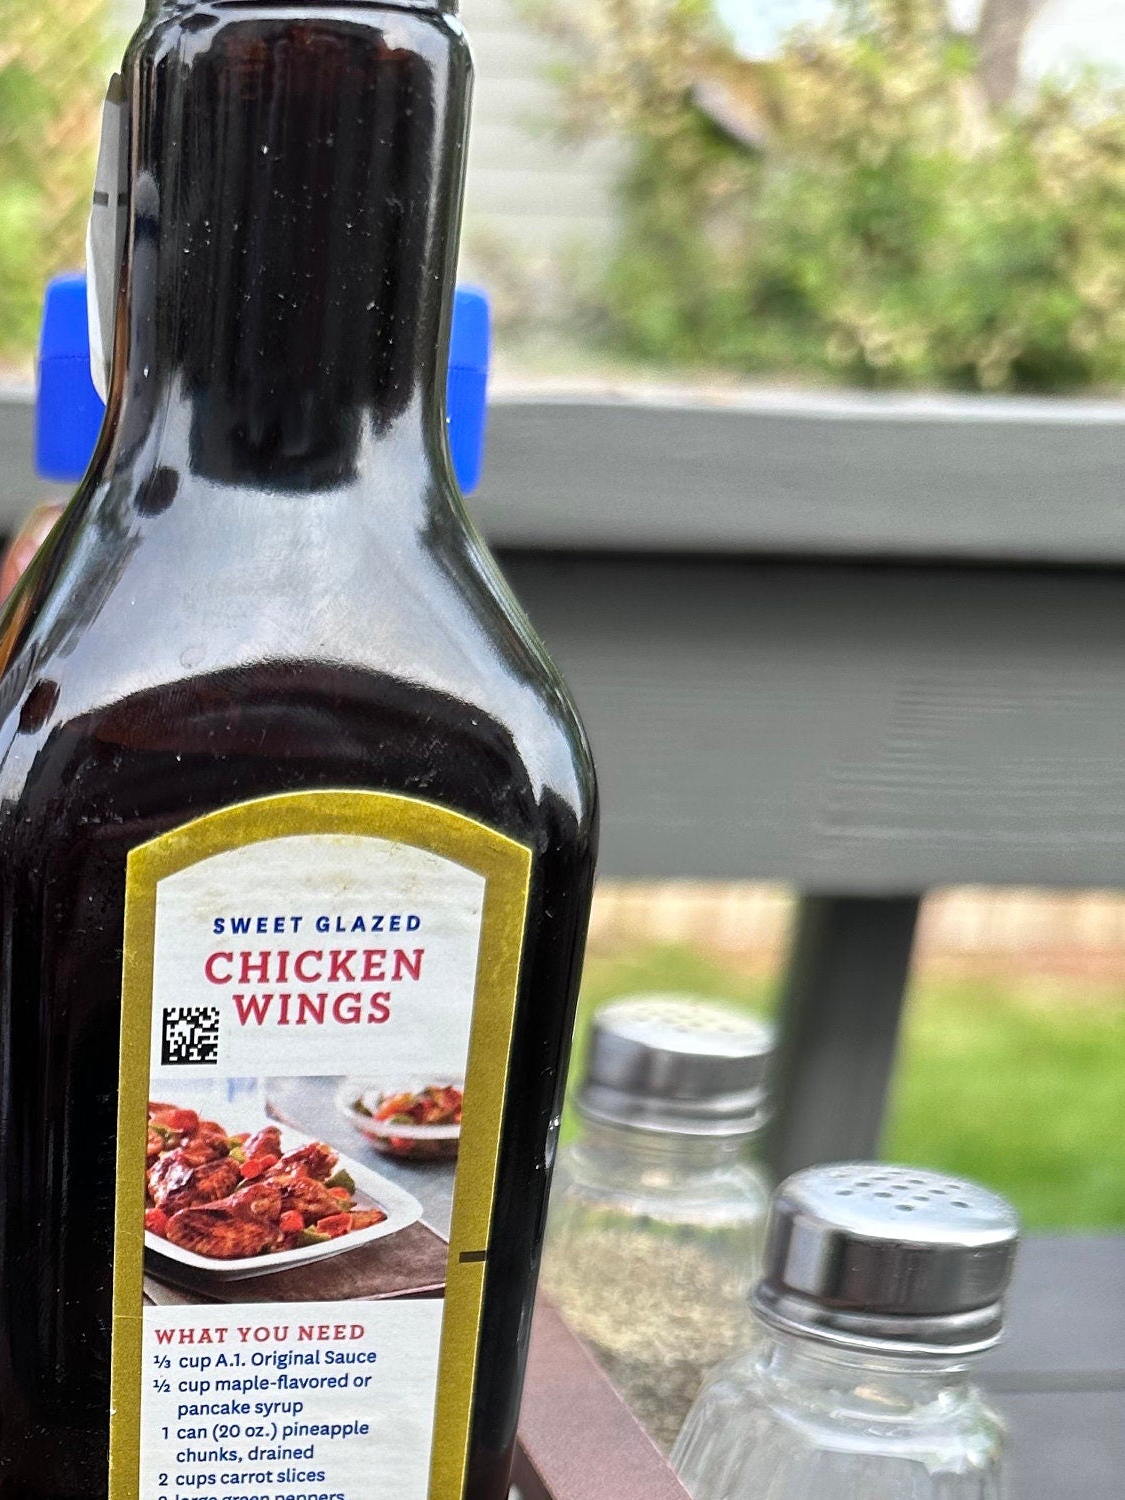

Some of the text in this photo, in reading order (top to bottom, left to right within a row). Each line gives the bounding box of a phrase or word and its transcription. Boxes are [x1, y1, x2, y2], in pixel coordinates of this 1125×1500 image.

[213, 915, 422, 935] SWEET GLAZED
[204, 949, 425, 984] CHICKEN
[232, 991, 392, 1026] WINGS
[155, 1324, 365, 1344] WHAT YOU NEED
[179, 1355, 211, 1370] cup
[215, 1352, 246, 1367] A.1.
[251, 1351, 320, 1369] Original
[325, 1350, 376, 1364] Sauce
[178, 1380, 210, 1395] cup
[215, 1374, 348, 1393] maple-flavored
[353, 1376, 372, 1387] or
[178, 1399, 303, 1419] pancake syrup
[162, 1421, 368, 1441] 1 can (20 oz.) pineapple
[176, 1445, 314, 1464] chunks, drained
[159, 1468, 325, 1487] 2 cups carrot slices
